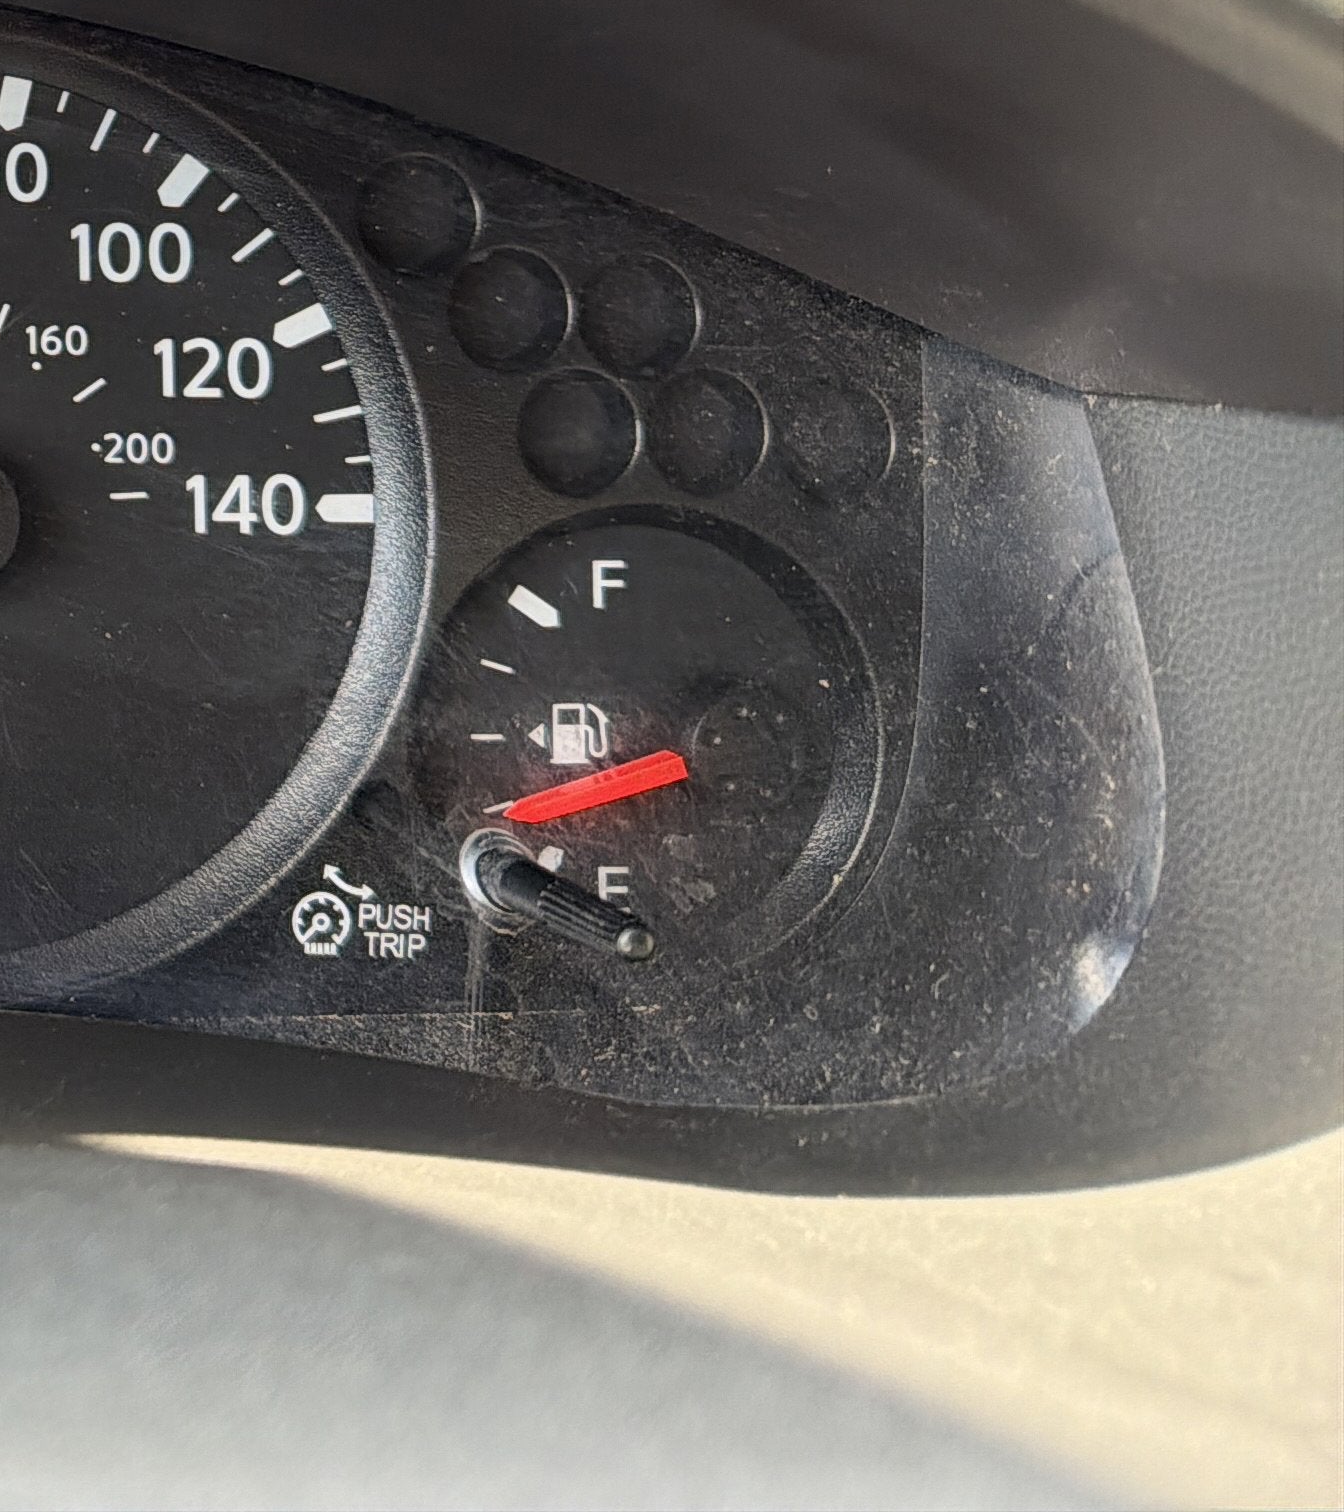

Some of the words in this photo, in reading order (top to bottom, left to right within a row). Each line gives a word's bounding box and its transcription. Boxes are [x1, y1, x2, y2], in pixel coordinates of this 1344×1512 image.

[71, 223, 191, 283] 100
[26, 325, 87, 355] 160
[154, 336, 271, 398] 120
[104, 433, 173, 463] 200
[186, 474, 304, 535] 140
[593, 560, 625, 608] F
[359, 903, 429, 931] PUSH
[364, 932, 426, 958] TRIP
